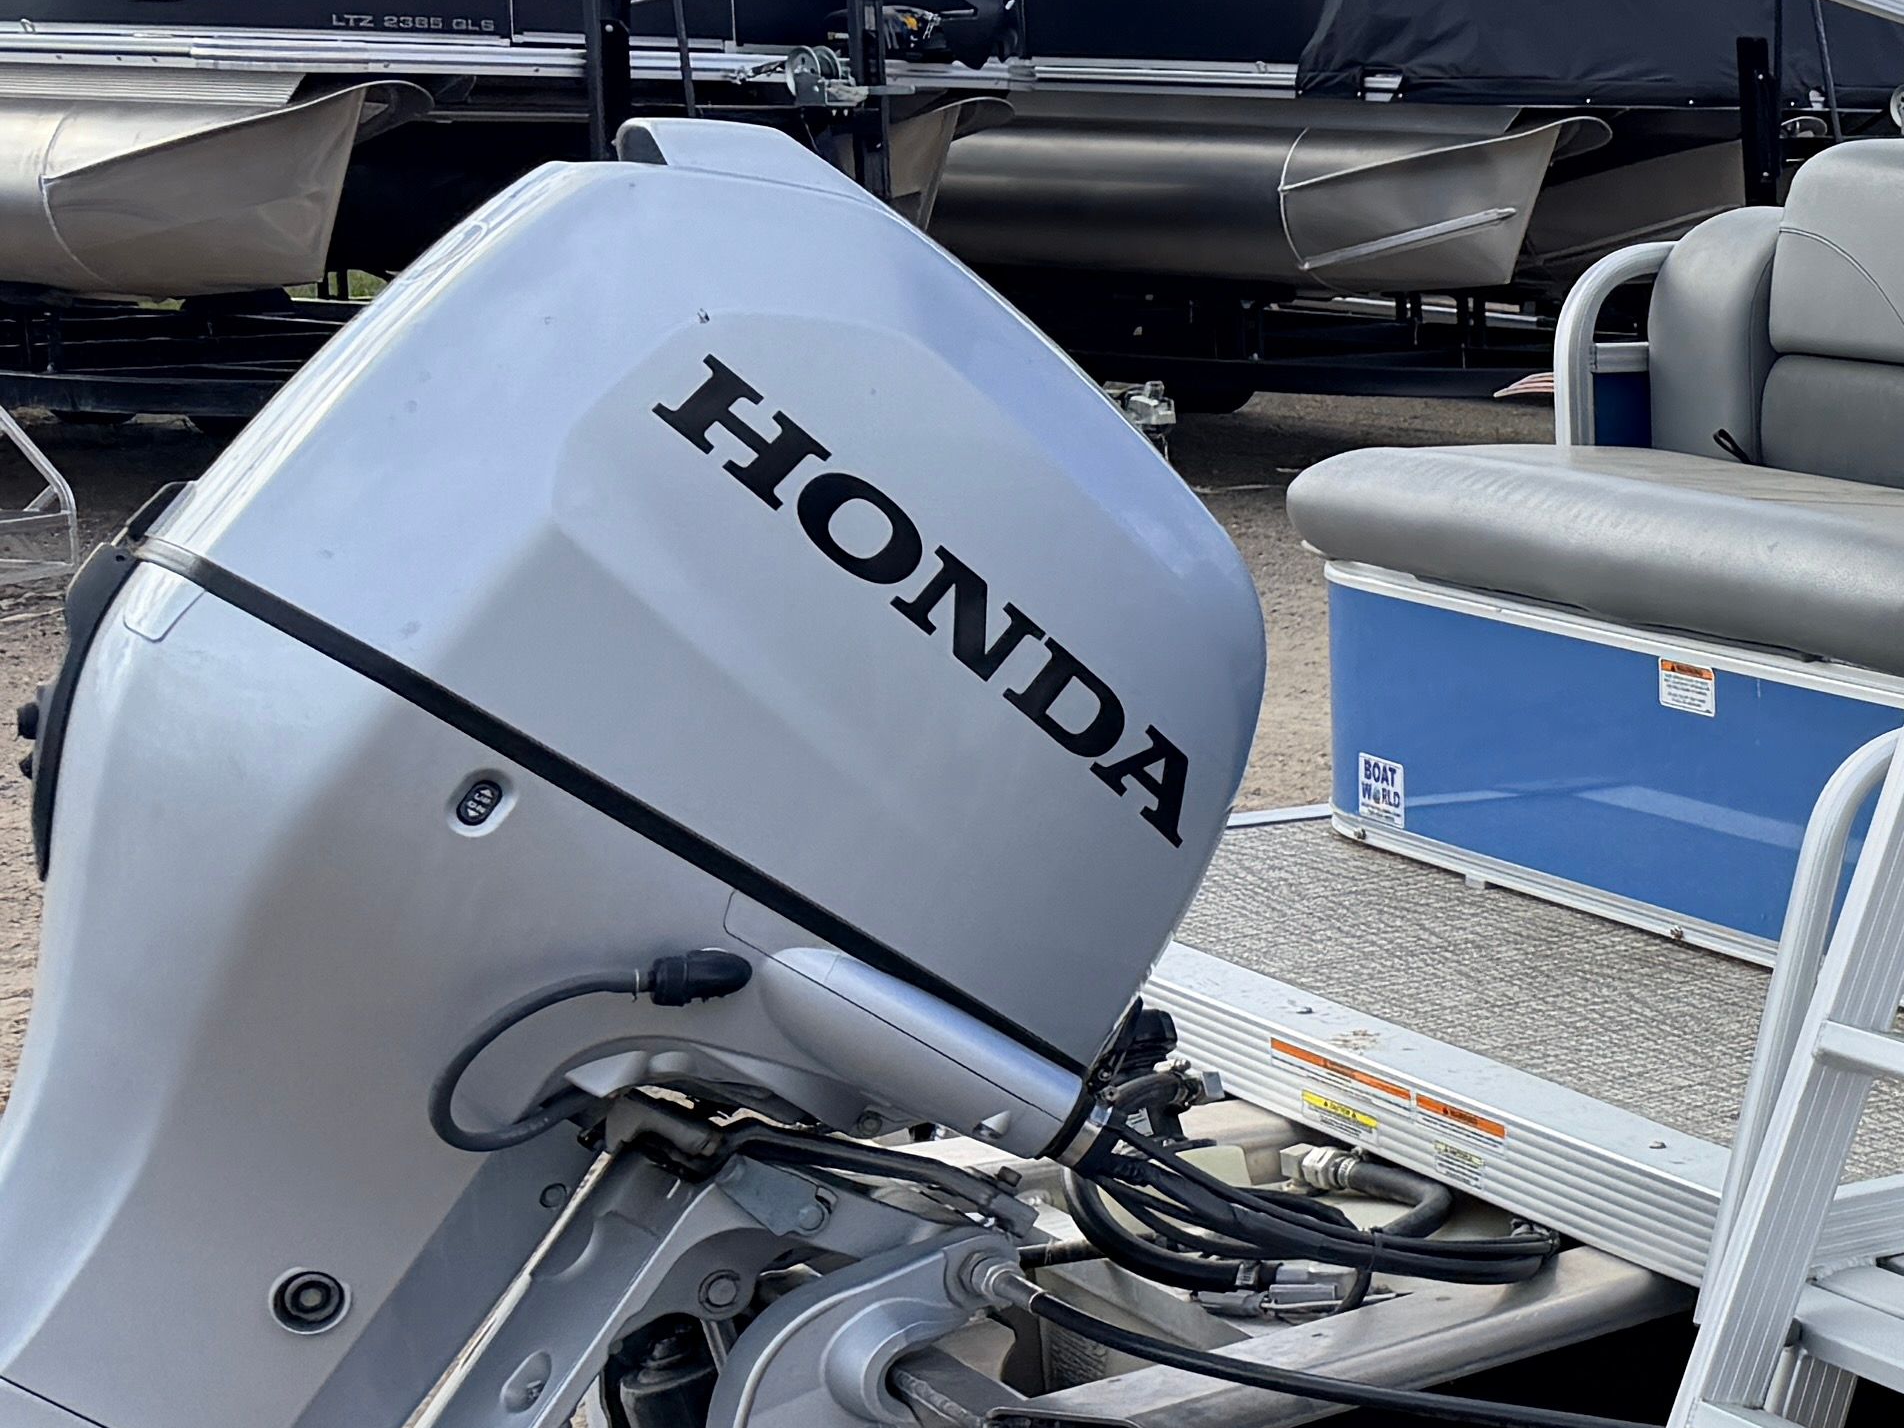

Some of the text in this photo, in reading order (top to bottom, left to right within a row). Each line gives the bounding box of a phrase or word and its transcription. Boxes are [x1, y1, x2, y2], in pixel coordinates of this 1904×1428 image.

[331, 13, 375, 28] LTZ
[652, 353, 1189, 848] HONDA
[1364, 758, 1397, 788] BOAT
